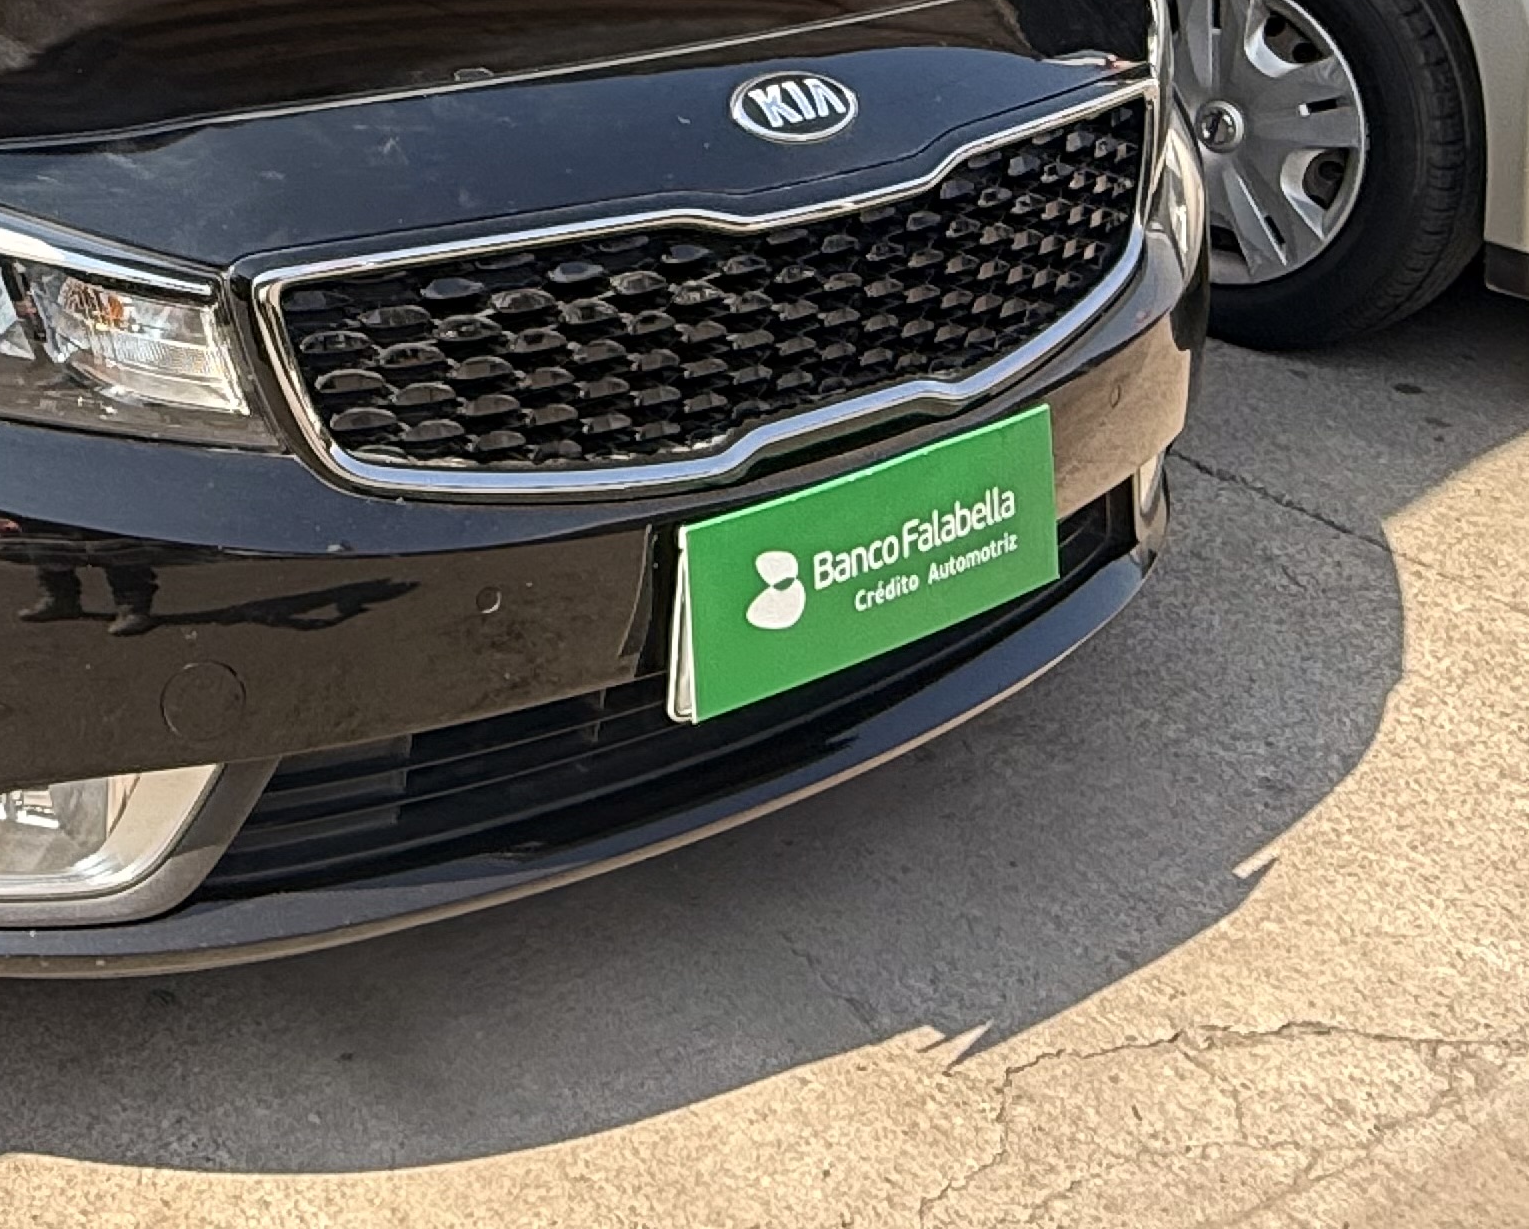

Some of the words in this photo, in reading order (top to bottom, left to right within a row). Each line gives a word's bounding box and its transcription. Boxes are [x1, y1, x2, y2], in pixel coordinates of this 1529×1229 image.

[747, 78, 847, 128] KIA
[812, 533, 900, 591] Banco
[901, 486, 1016, 559] Falabella
[854, 572, 920, 612] Crédito
[927, 531, 1019, 585] Automotriz
